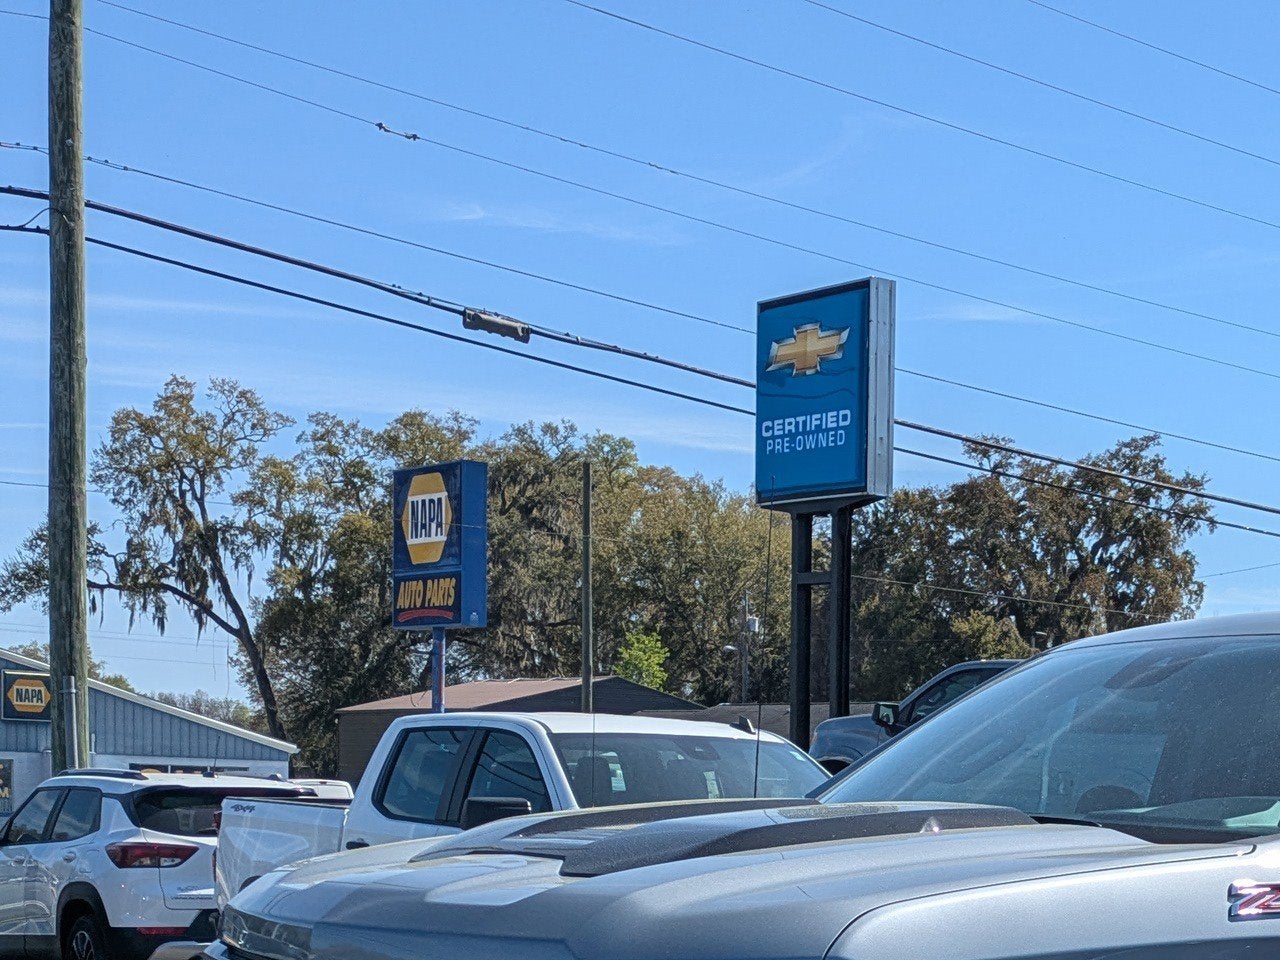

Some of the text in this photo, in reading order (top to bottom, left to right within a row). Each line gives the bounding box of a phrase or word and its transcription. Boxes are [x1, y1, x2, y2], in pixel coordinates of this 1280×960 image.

[761, 409, 851, 437] CERTIFIED
[766, 429, 846, 455] PRE-OWNED
[409, 496, 444, 540] NAPA
[396, 577, 457, 610] AUTO PARTS
[15, 687, 44, 704] NAPA
